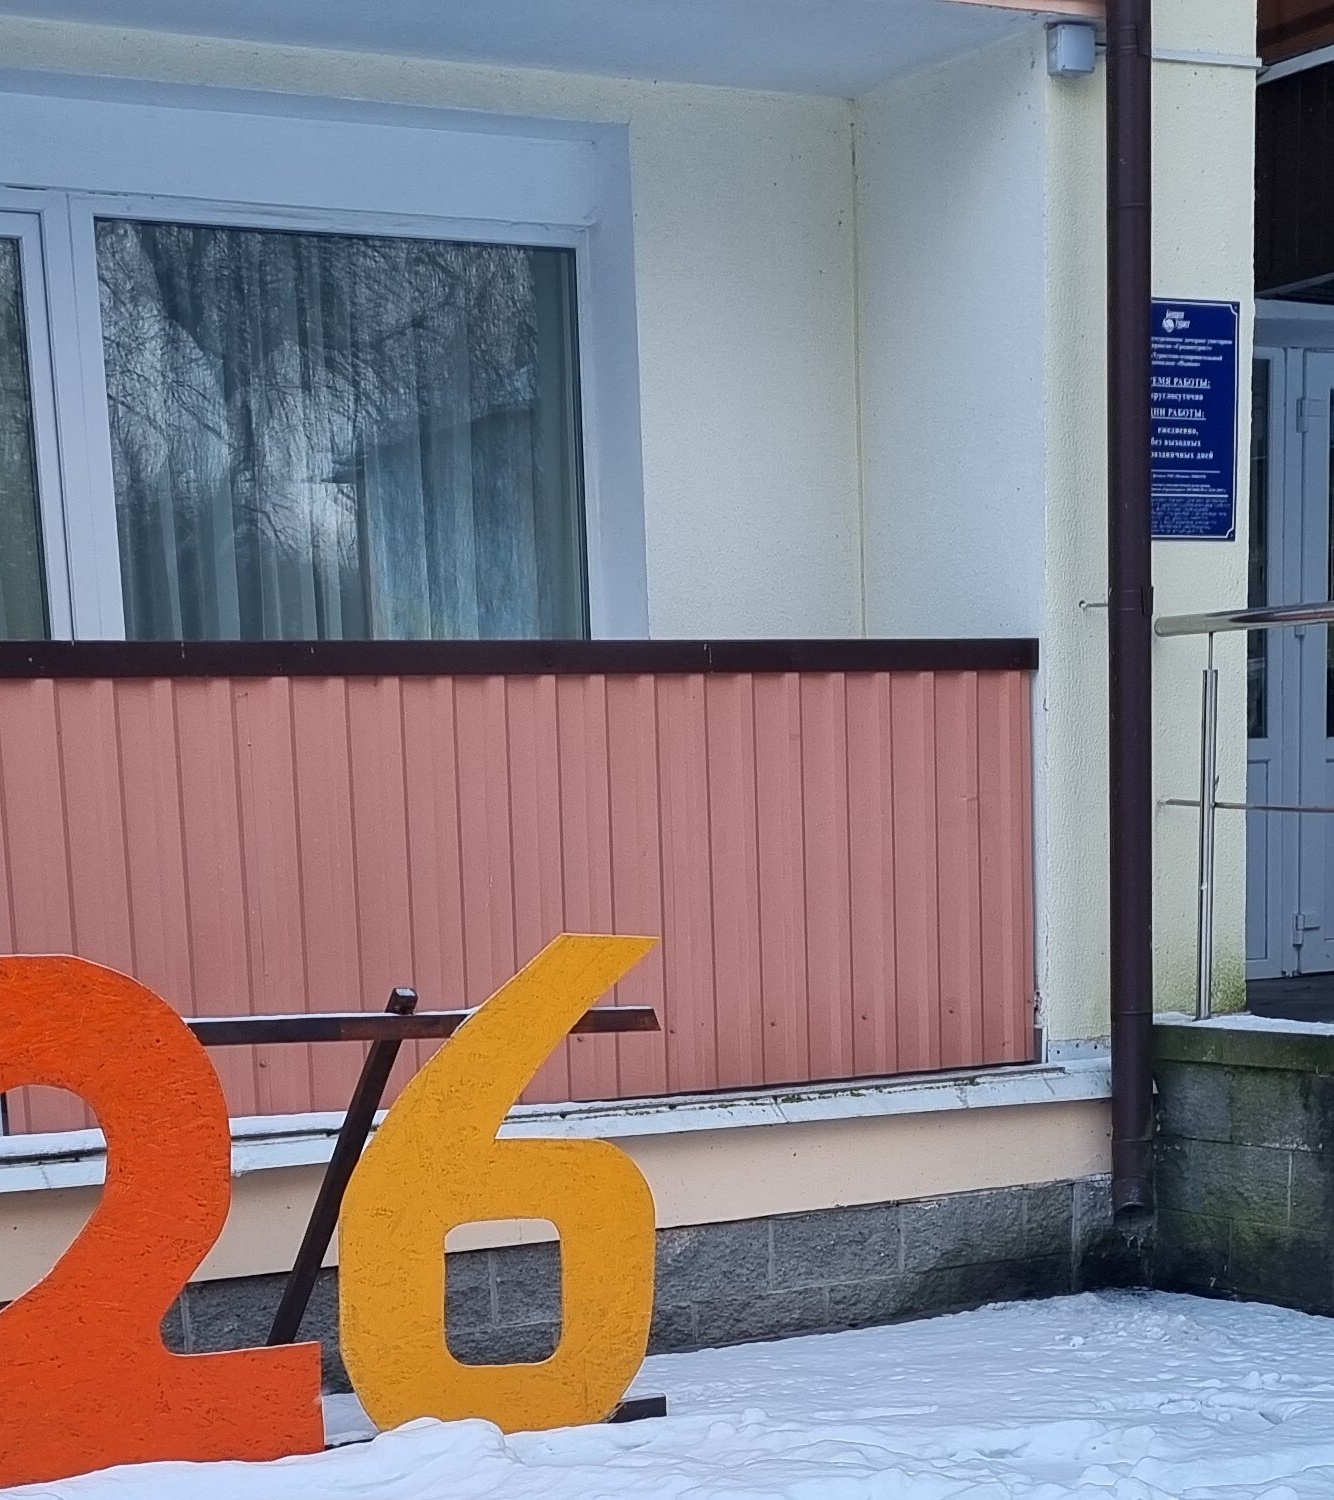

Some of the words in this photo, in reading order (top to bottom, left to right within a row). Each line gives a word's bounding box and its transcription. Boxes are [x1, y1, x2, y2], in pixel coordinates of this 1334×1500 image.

[1151, 376, 1171, 386] ЕМЯ
[1173, 377, 1211, 388] РАБОТЫ:
[1168, 408, 1205, 418] РАБОТЫ:
